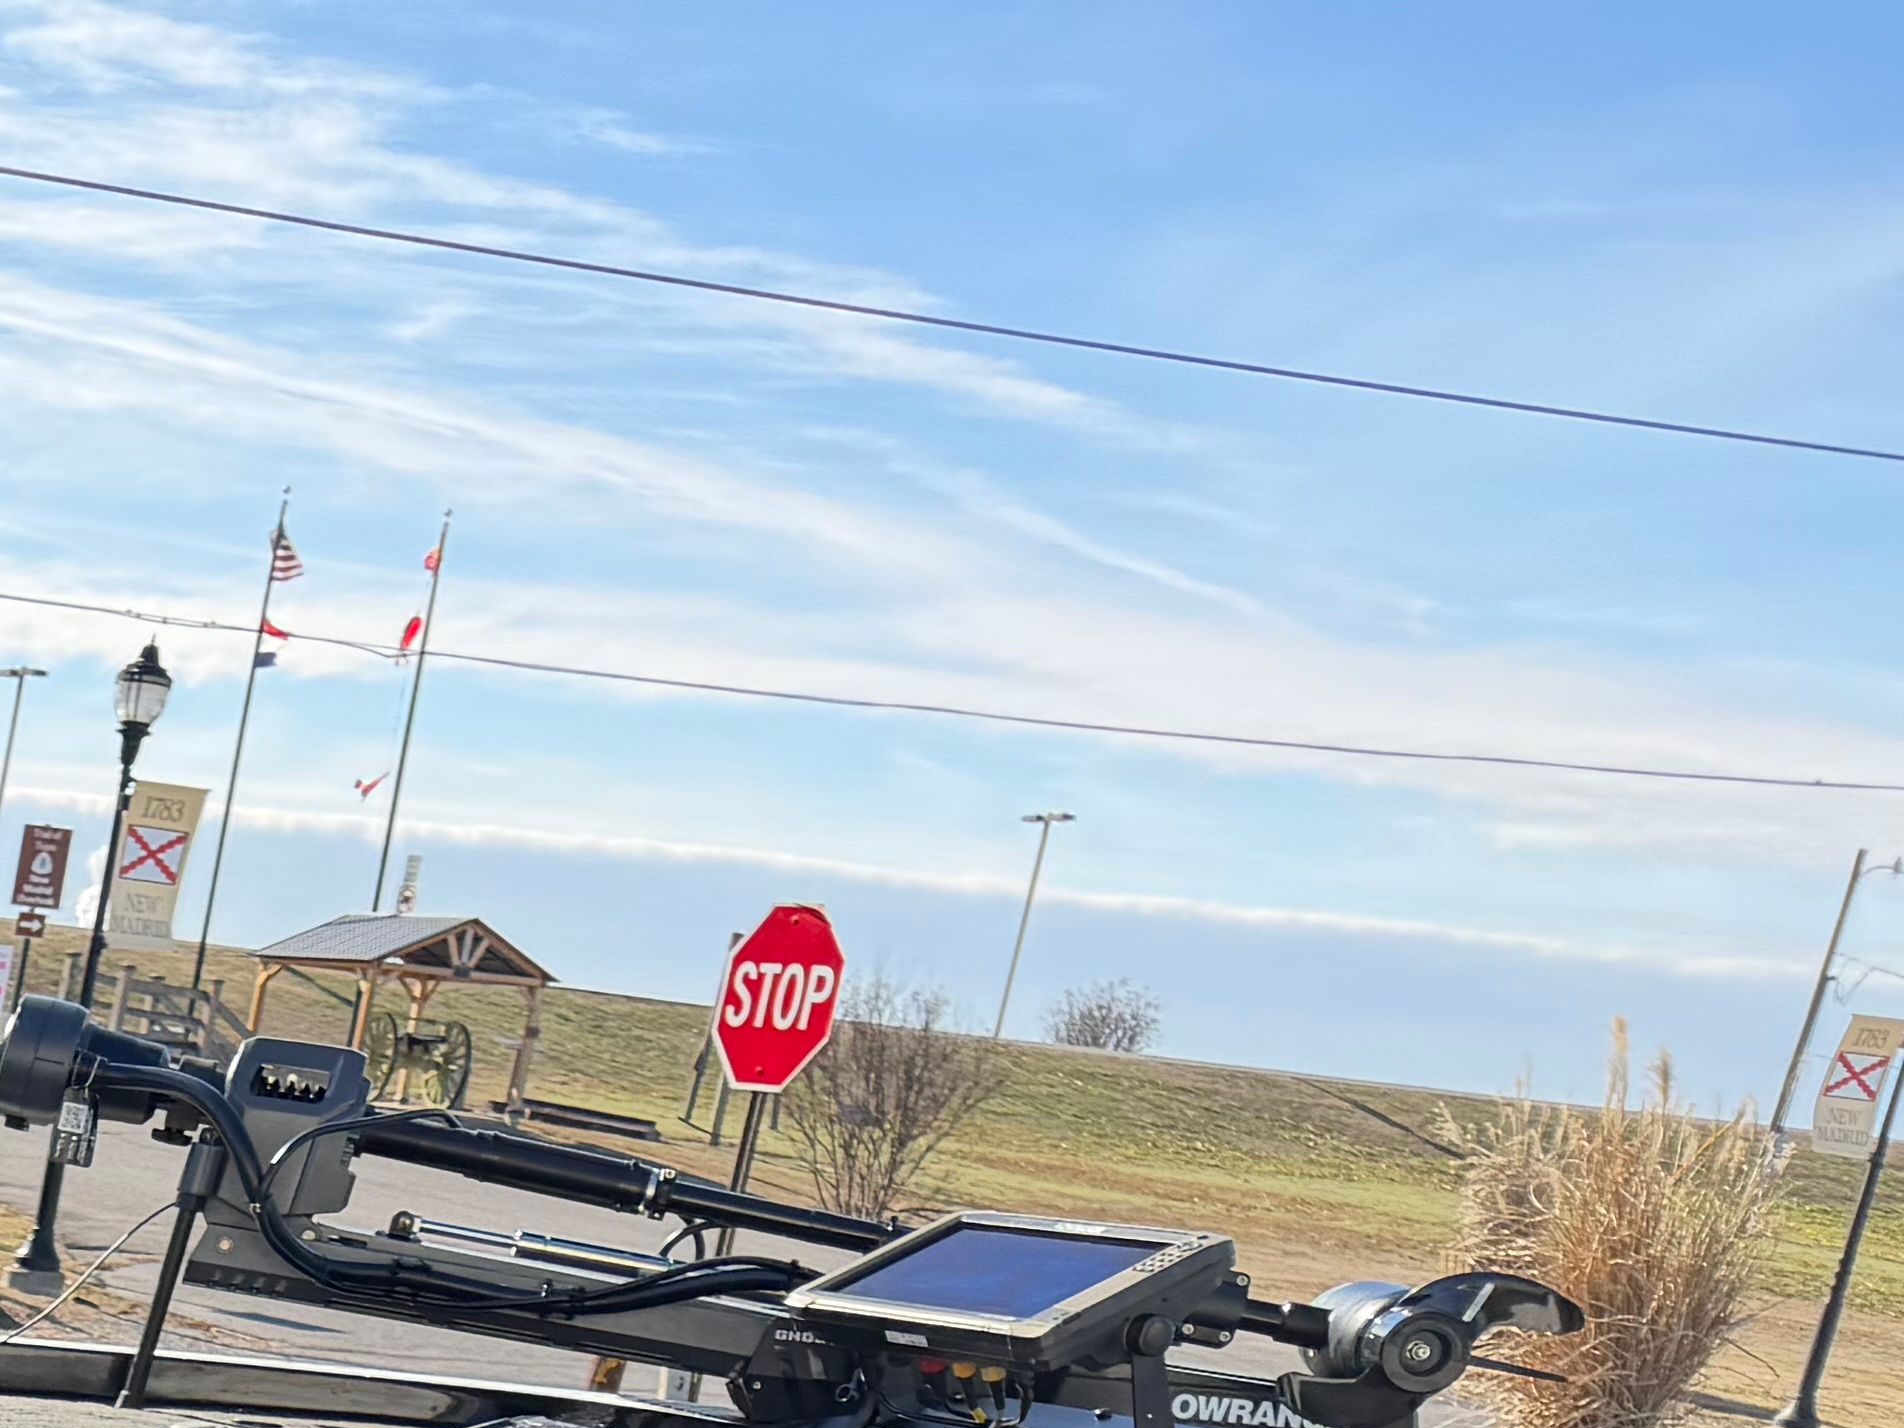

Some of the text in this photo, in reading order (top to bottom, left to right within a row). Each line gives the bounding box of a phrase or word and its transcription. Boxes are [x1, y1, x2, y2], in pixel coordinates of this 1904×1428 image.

[142, 795, 186, 823] 1783
[724, 959, 836, 1032] STOP
[773, 1327, 835, 1347] GHO
